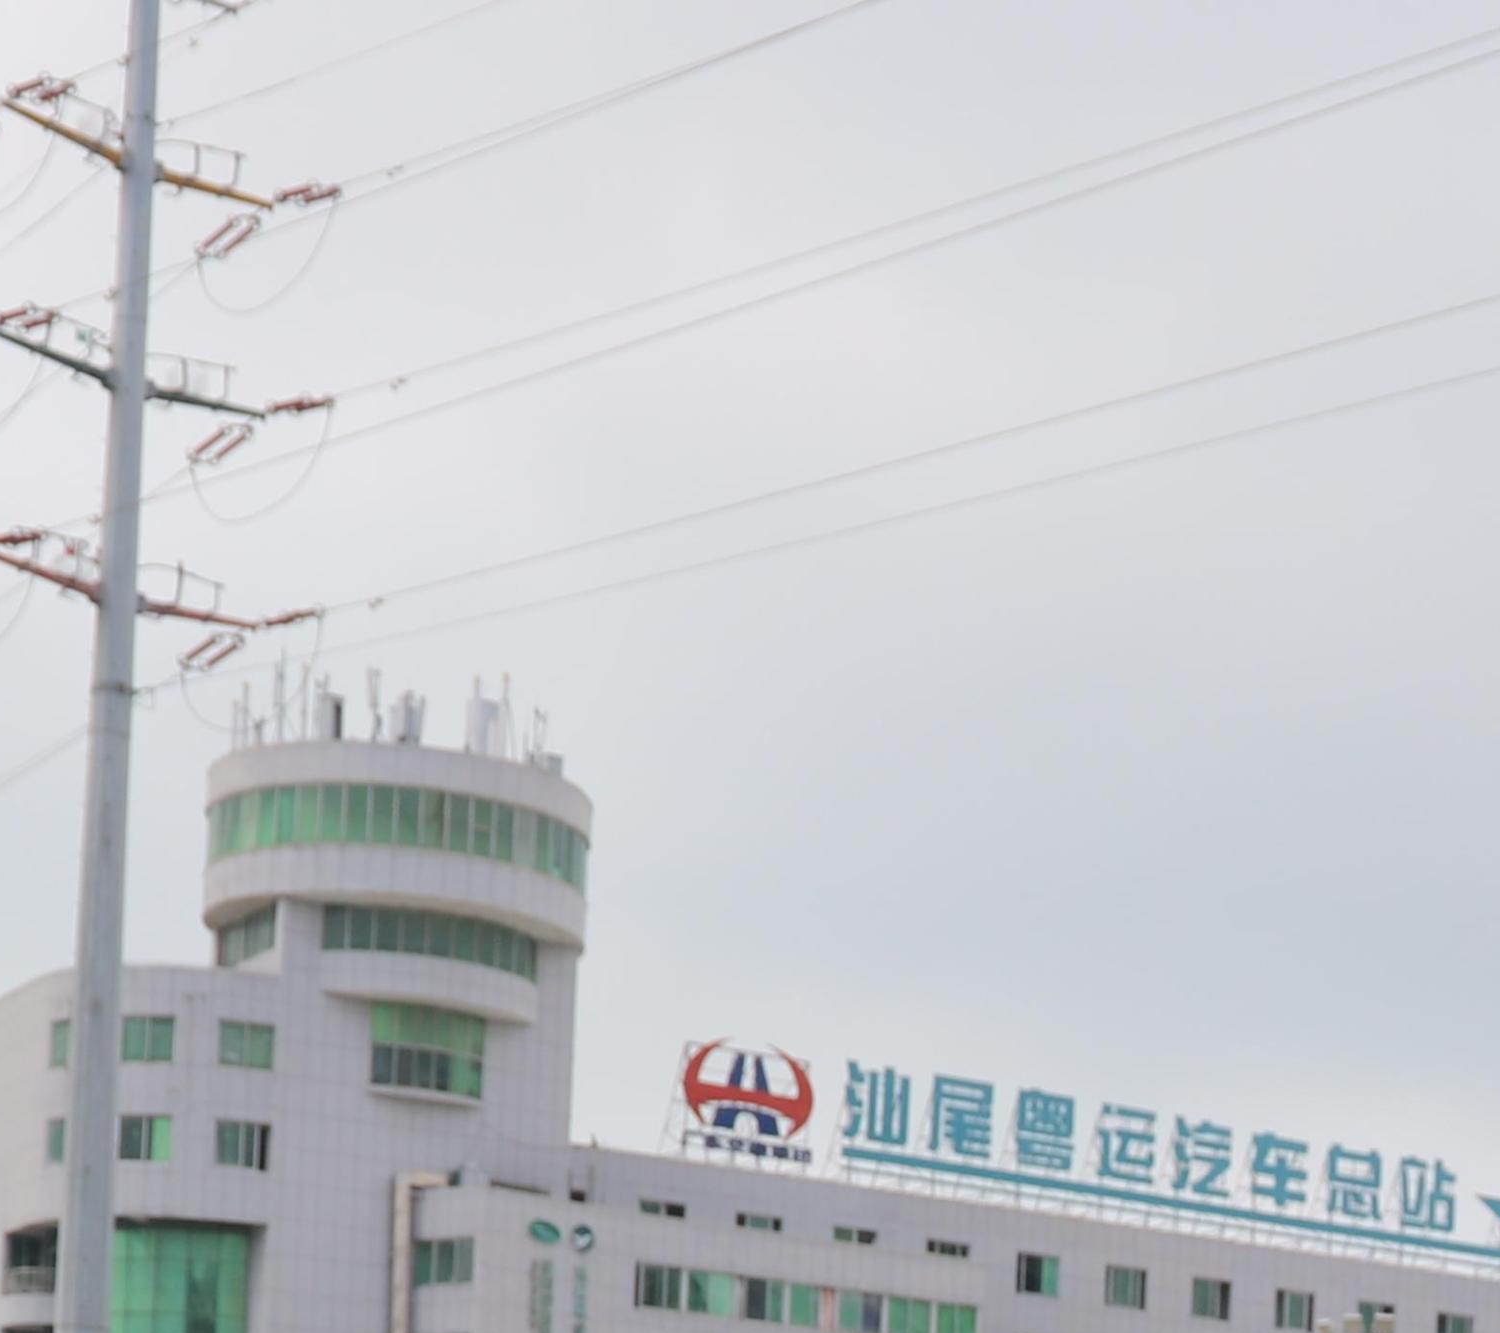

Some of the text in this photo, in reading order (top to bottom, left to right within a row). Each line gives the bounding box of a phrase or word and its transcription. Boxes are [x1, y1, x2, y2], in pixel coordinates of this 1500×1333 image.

[842, 1060, 1456, 1233] 汕尾粤运汽车总站
